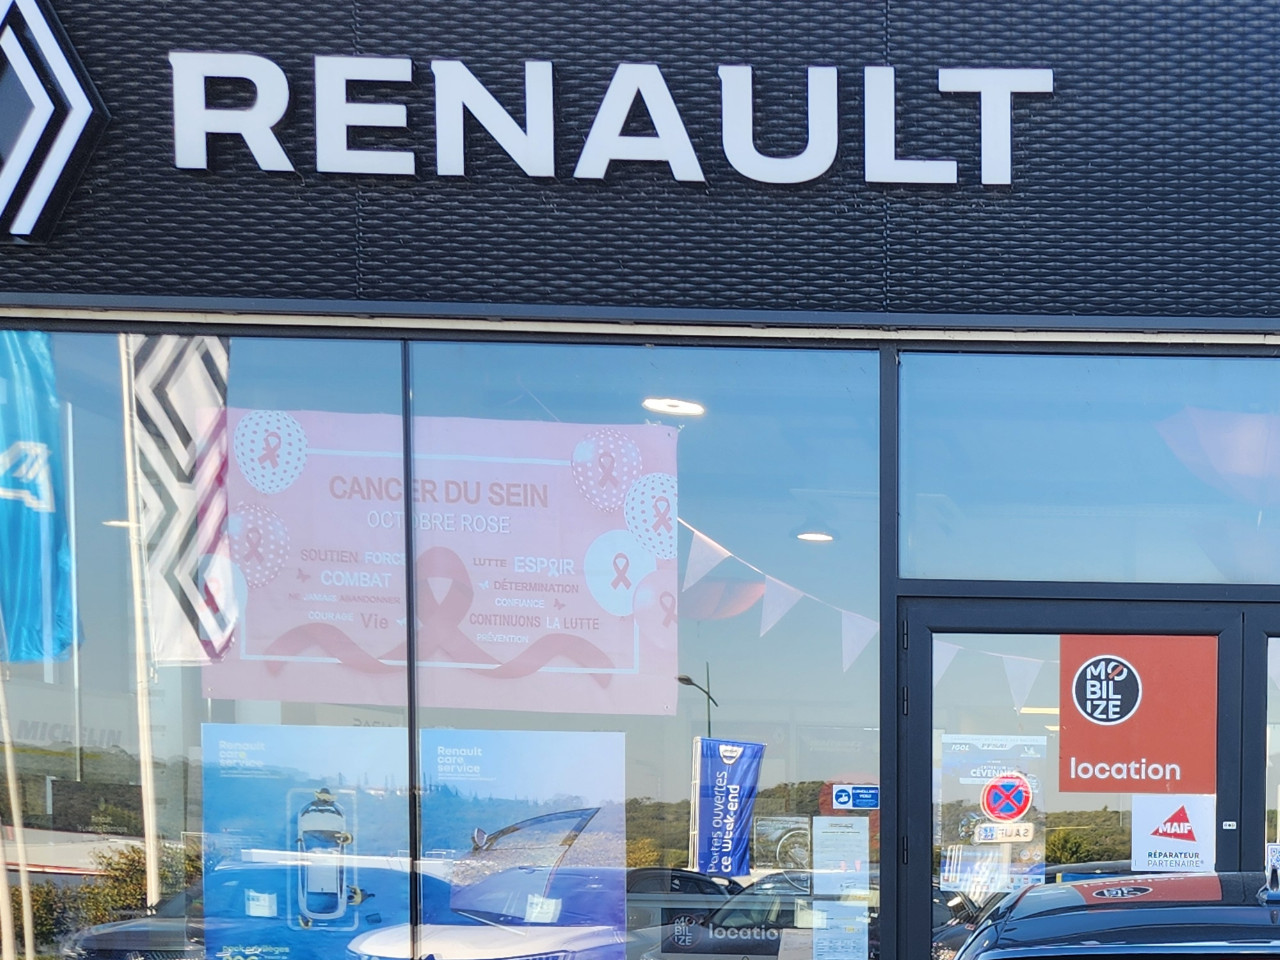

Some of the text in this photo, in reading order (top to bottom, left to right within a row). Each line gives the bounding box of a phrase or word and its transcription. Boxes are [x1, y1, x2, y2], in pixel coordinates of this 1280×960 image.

[169, 51, 1055, 186] RENAULT
[329, 475, 549, 508] CANCER DU SEIN
[367, 510, 511, 534] OCTBRE ROSE
[300, 548, 406, 566] SOUTIEN FORCE
[473, 557, 507, 568] LUTTE
[320, 569, 393, 588] COMBAT
[493, 578, 580, 594] DÉTERMINATION
[494, 597, 545, 609] CONFIANCE
[308, 610, 389, 630] COURAGE Vie
[469, 612, 600, 631] CONTINUONS LA LUTTE
[476, 632, 529, 644] PRÉVENTION
[218, 740, 266, 751] Renault
[437, 746, 483, 757] Renault
[218, 751, 247, 759] care
[218, 758, 265, 768] service
[437, 756, 464, 764] care
[437, 764, 481, 773] service
[1070, 756, 1181, 781] location
[707, 770, 728, 873] Portes ouvertes
[721, 784, 741, 873] ce week-end
[1158, 821, 1194, 835] MAIF
[1147, 850, 1200, 860] RÉPARATEUR
[708, 922, 782, 942] locatio
